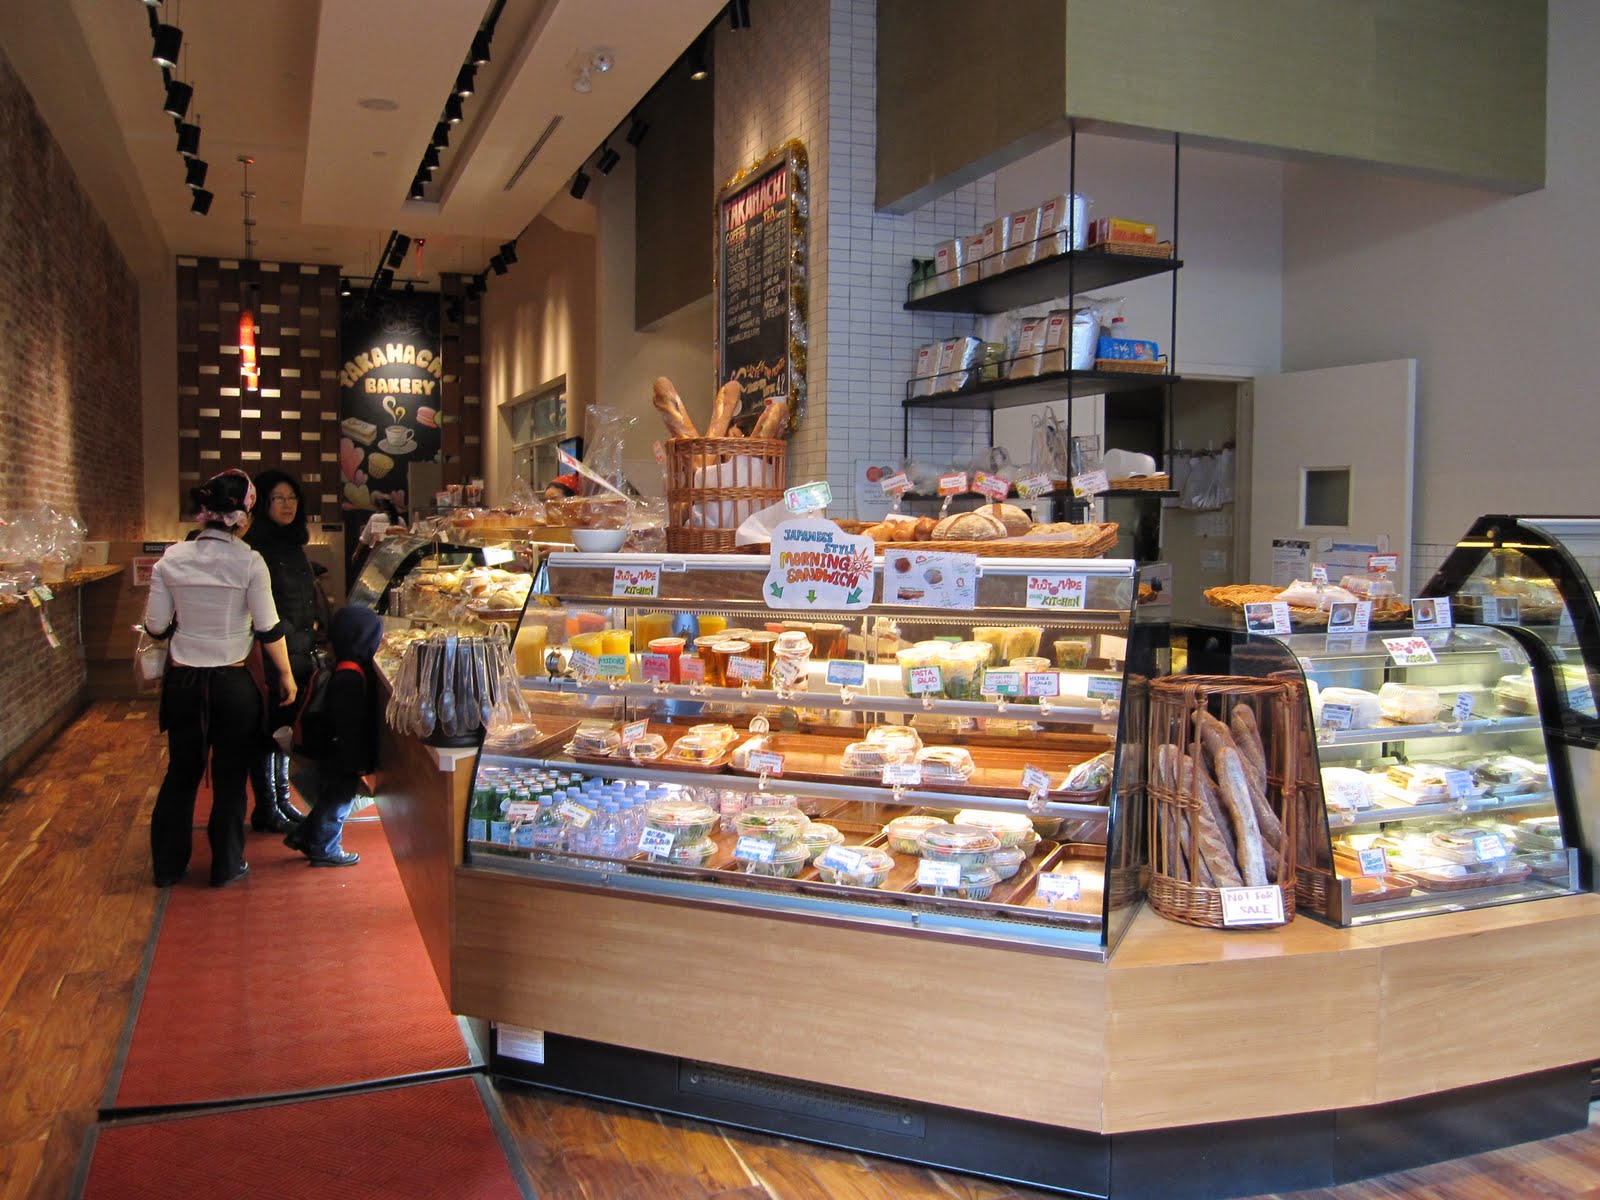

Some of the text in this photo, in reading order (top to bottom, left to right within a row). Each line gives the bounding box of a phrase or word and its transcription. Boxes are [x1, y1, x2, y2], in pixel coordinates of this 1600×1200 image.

[725, 171, 787, 231] TAKAHACHI
[365, 377, 436, 396] BAKERY
[783, 529, 834, 543] JAPANESE
[824, 543, 856, 555] STYLE
[780, 551, 851, 571] MORNING
[615, 569, 657, 581] JUST MADE
[786, 567, 859, 589] SANDWICH
[1029, 577, 1082, 591] JUST MADE
[624, 585, 654, 596] KITCHEN
[1041, 595, 1081, 607] KITCHEN
[911, 669, 933, 678] PASTA
[917, 676, 938, 685] SALAD
[1227, 890, 1273, 902] NOT FOR
[1240, 904, 1272, 914] SALE
